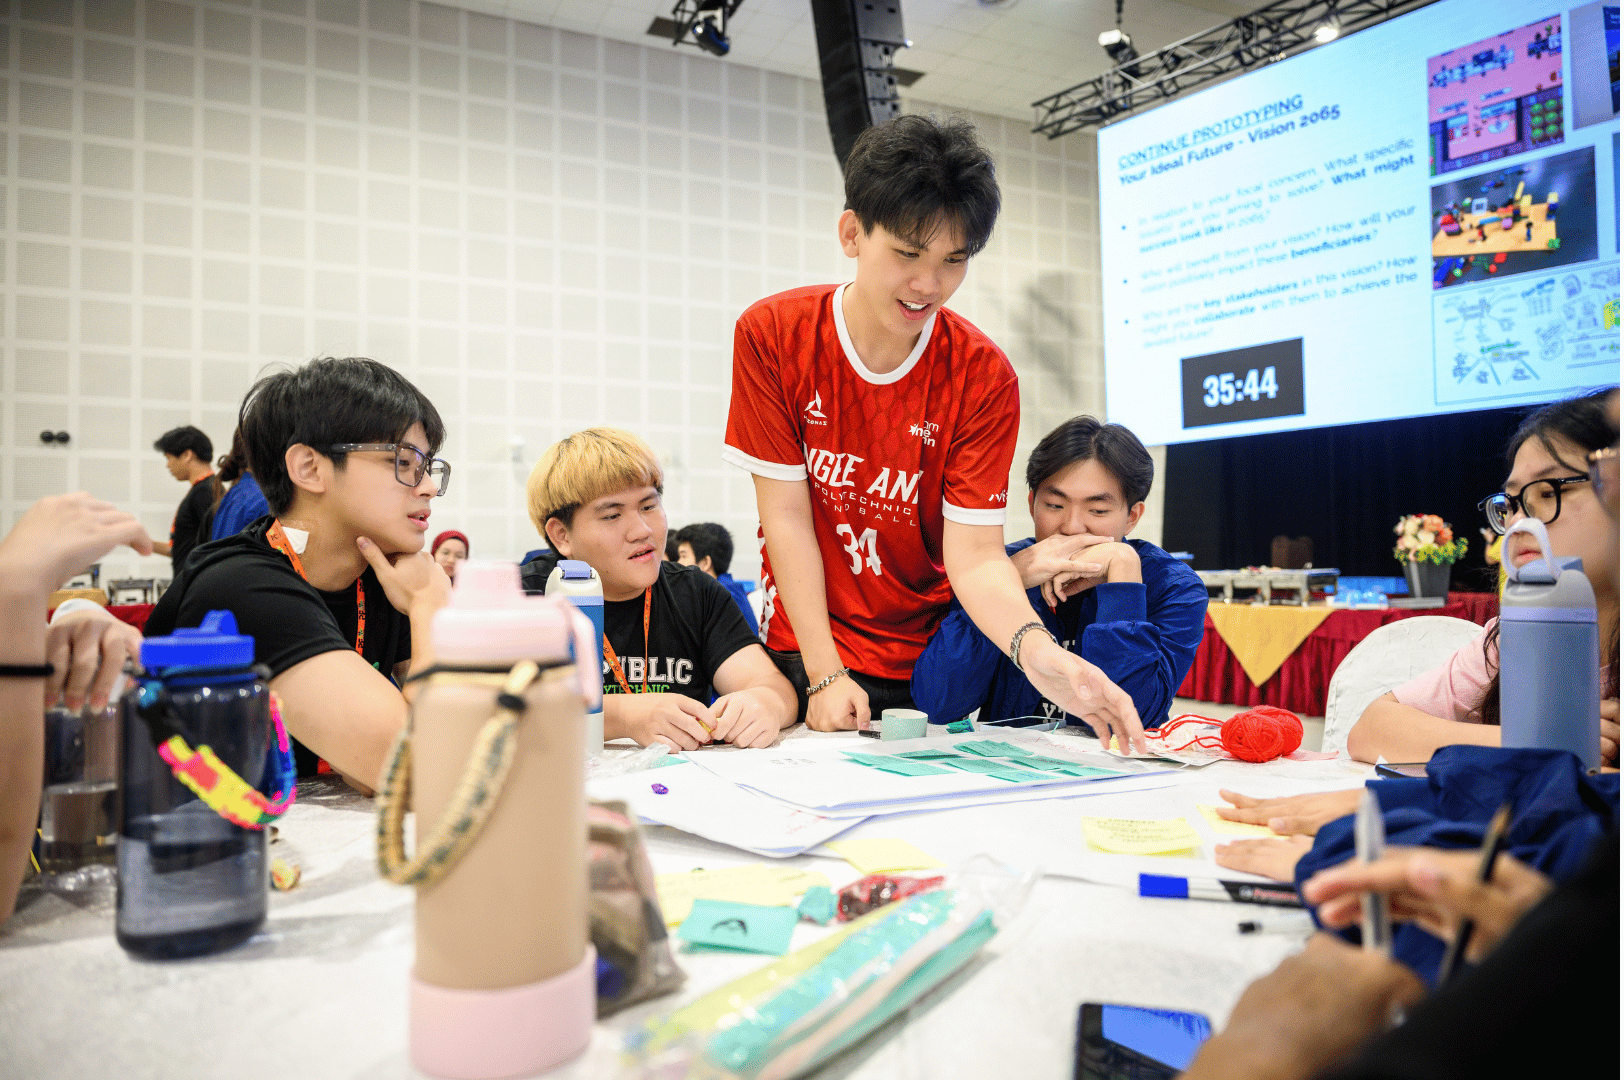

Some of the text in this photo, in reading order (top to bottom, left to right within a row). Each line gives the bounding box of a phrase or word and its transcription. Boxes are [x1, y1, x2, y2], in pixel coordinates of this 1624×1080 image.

[1118, 93, 1304, 170] CONTINUE PROTOTYPING
[1119, 170, 1147, 185] Your
[1150, 155, 1184, 175] Ideal
[1187, 141, 1235, 163] Future
[1247, 120, 1296, 143] Vision
[1299, 103, 1342, 128] 2065
[1324, 153, 1358, 172] What
[1364, 138, 1415, 162] specific
[1268, 193, 1281, 204] to
[1331, 167, 1367, 185] What
[1373, 153, 1415, 174] might
[1253, 239, 1278, 255] your
[1282, 226, 1322, 245] vision?
[1325, 221, 1354, 235] How
[1358, 211, 1381, 226] will
[1384, 205, 1416, 224] your
[1290, 228, 1379, 259] beneficiaries?
[1203, 298, 1222, 309] key
[1225, 281, 1299, 303] stakeholders
[1301, 277, 1313, 287] in
[1316, 273, 1338, 285] this
[1340, 259, 1384, 279] vision?
[1386, 254, 1418, 270] How
[1262, 298, 1285, 311] with
[1289, 292, 1320, 306] them
[1323, 287, 1337, 300] to
[1341, 277, 1391, 296] achieve
[1395, 272, 1419, 285] the
[1203, 366, 1279, 408] 35:44
[866, 466, 924, 505] AN
[836, 524, 882, 577] 34
